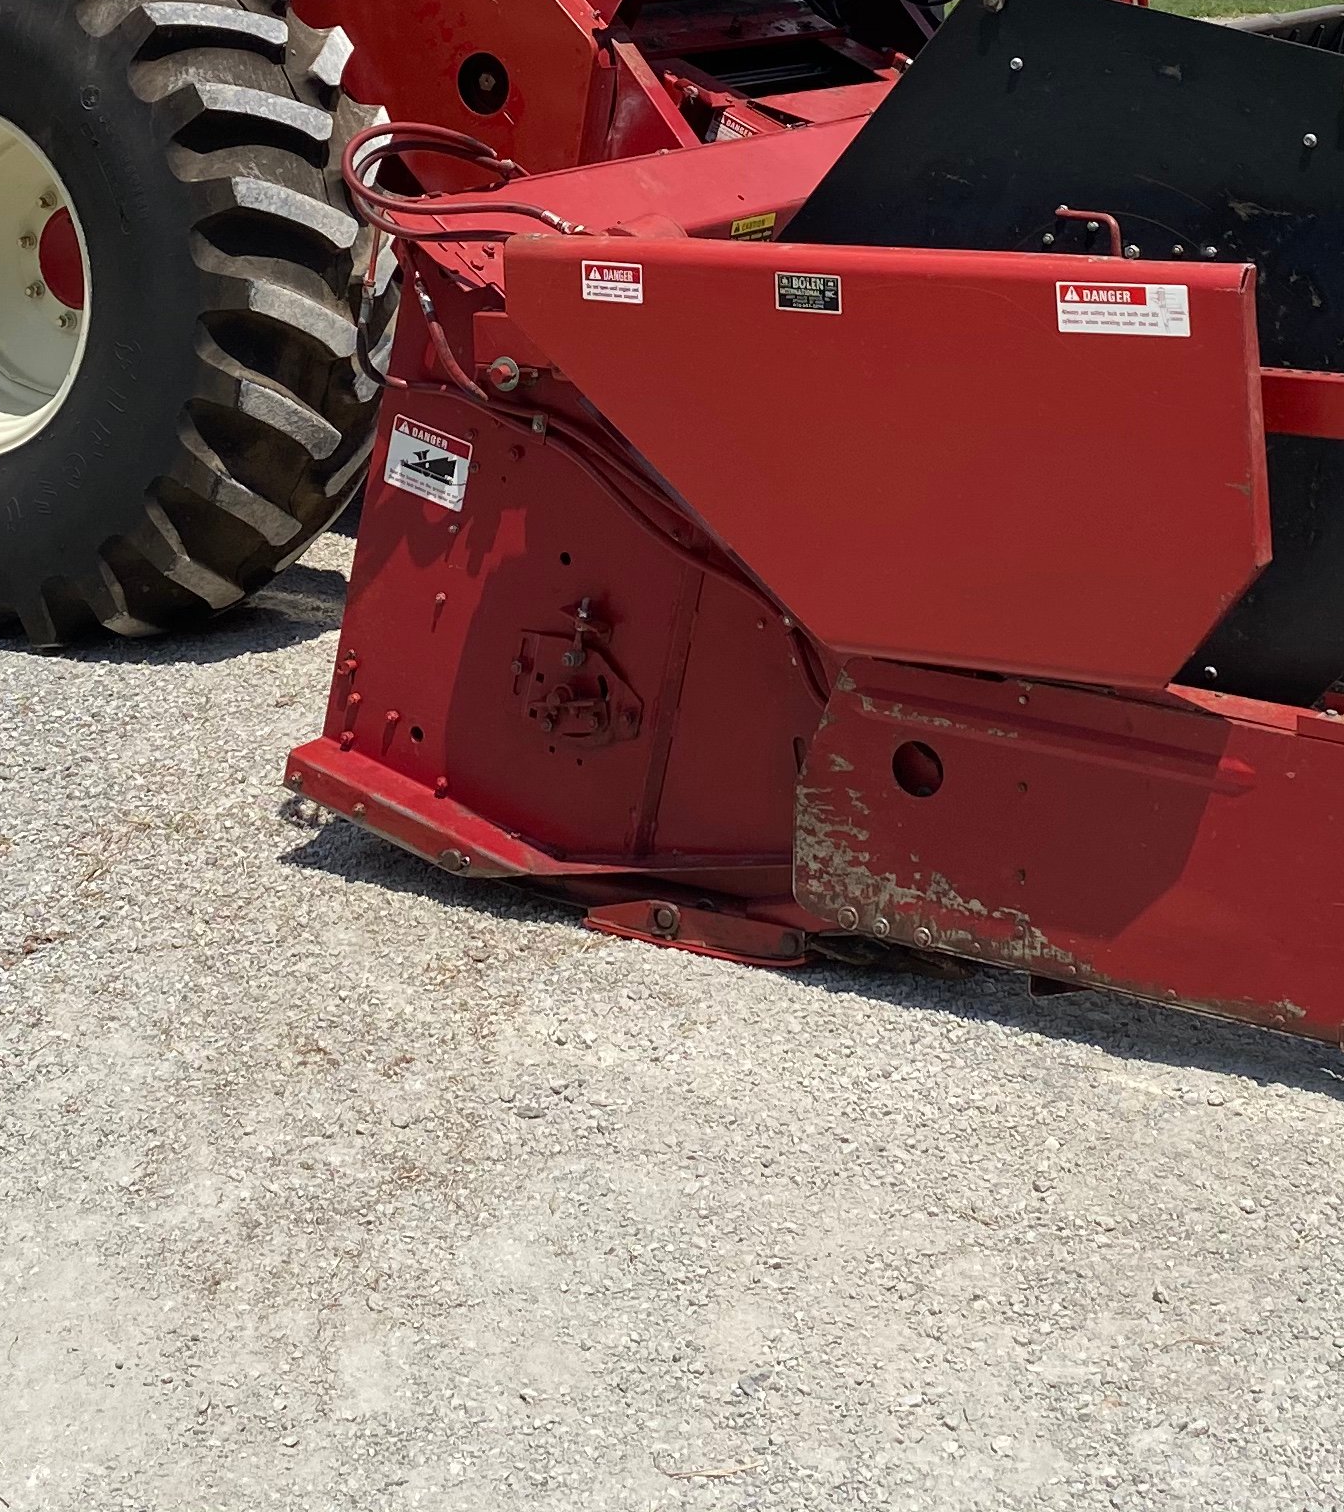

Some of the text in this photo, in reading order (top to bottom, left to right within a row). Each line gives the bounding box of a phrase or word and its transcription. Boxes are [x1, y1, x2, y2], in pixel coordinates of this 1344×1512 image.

[603, 269, 634, 282] DANGER
[792, 276, 824, 291] BOLEN
[1082, 289, 1132, 303] DANGER
[412, 428, 448, 450] DANGER
